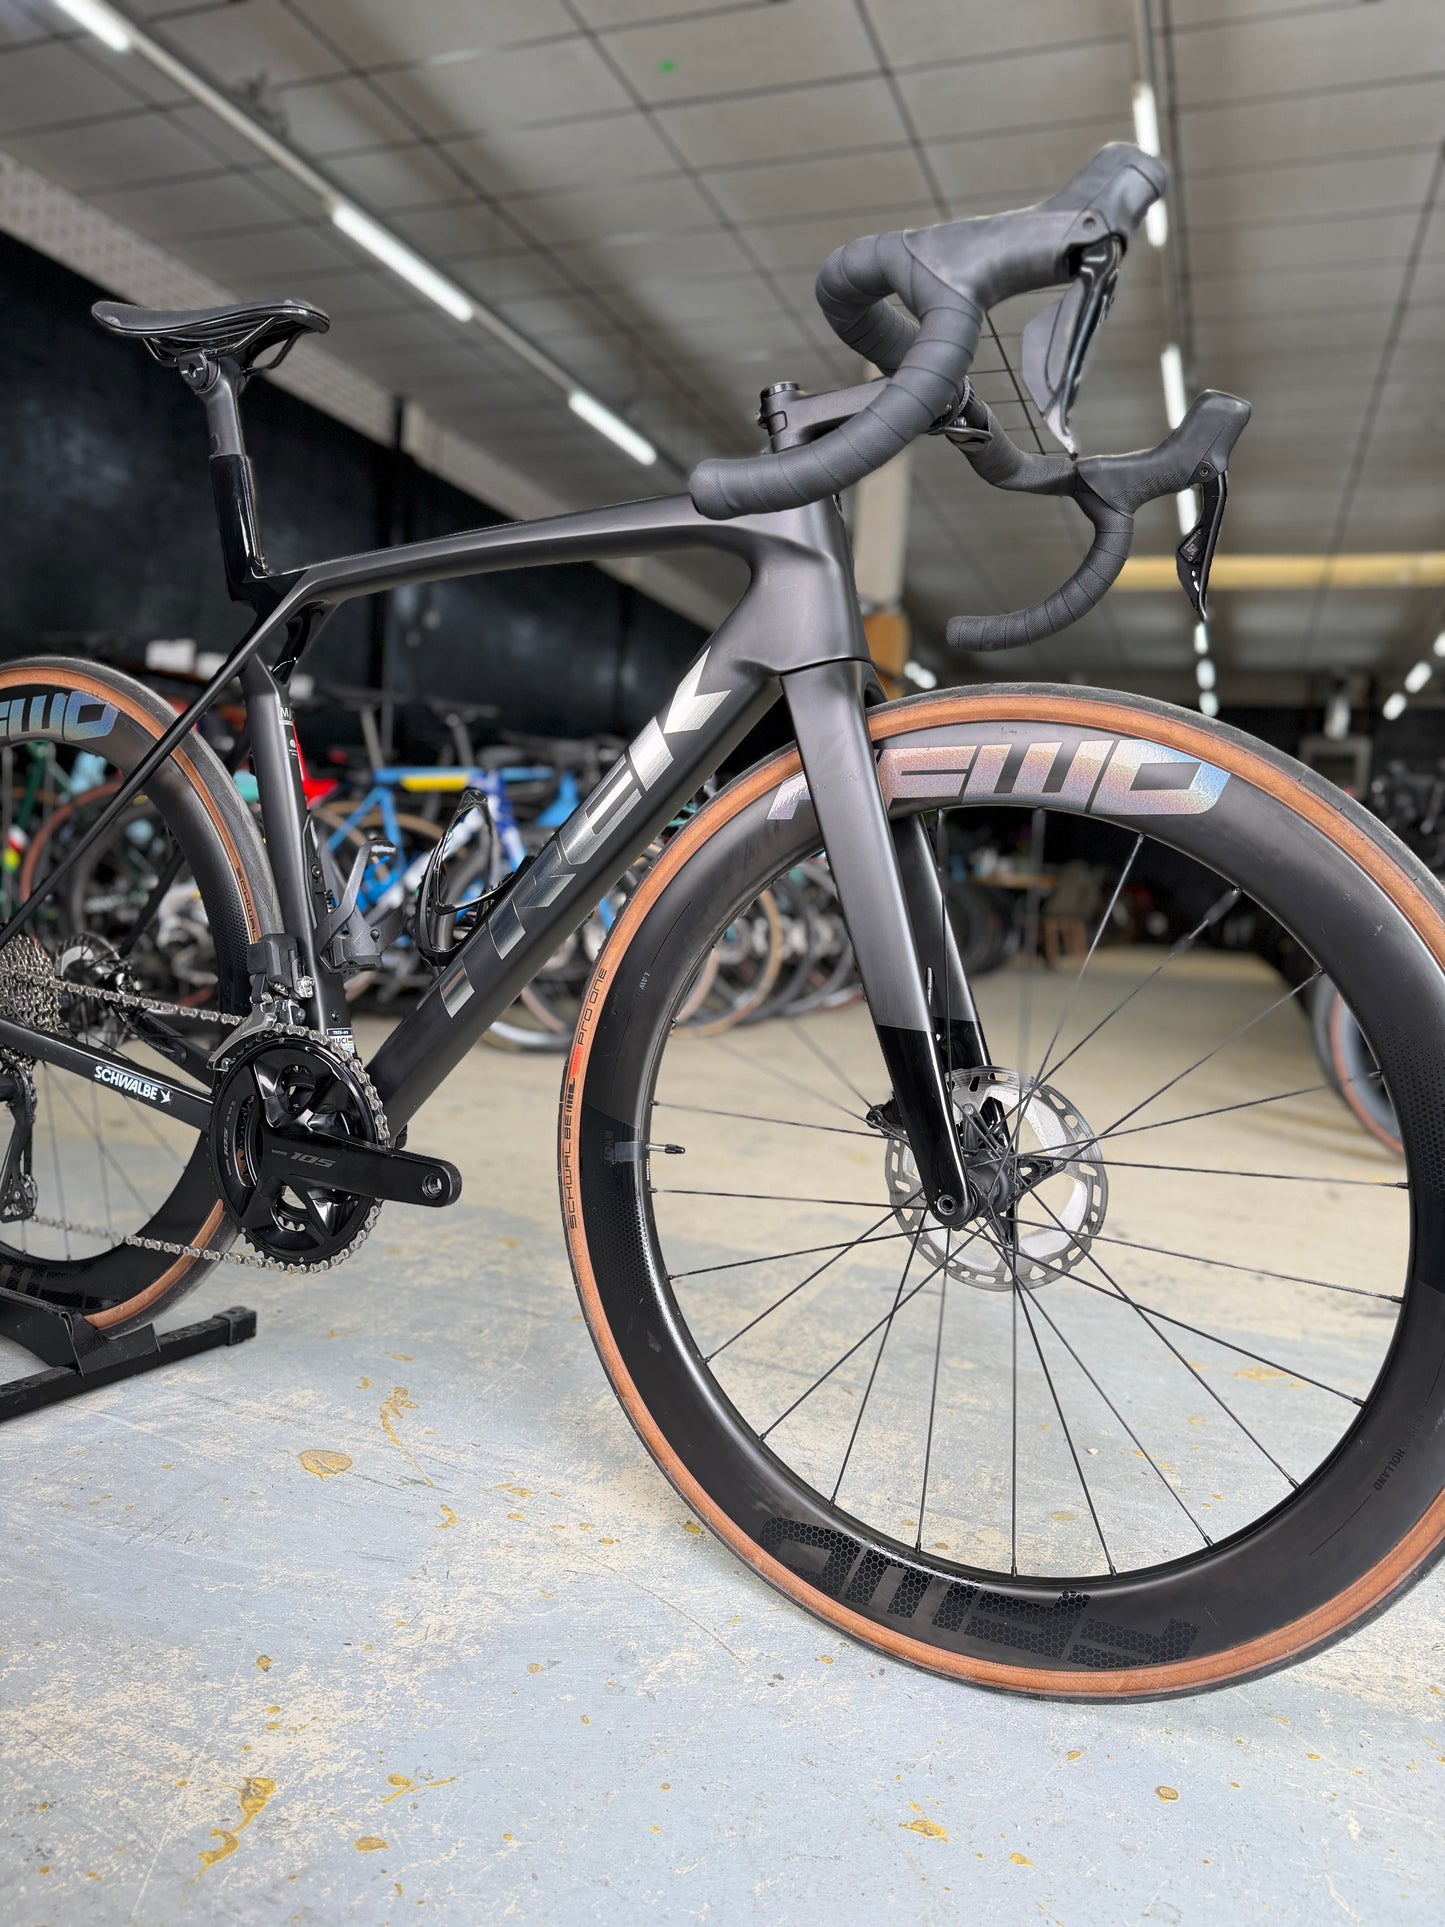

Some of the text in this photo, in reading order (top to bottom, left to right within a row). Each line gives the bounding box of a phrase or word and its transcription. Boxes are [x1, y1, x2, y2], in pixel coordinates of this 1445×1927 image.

[416, 646, 732, 1018] TREK
[236, 867, 256, 942] SCHWAL
[94, 1065, 159, 1101] SCHWALBE
[563, 967, 608, 1229] SCHWALBE PRO ONE
[290, 1151, 336, 1168] 105
[1372, 1448, 1406, 1491] HOLLAND
